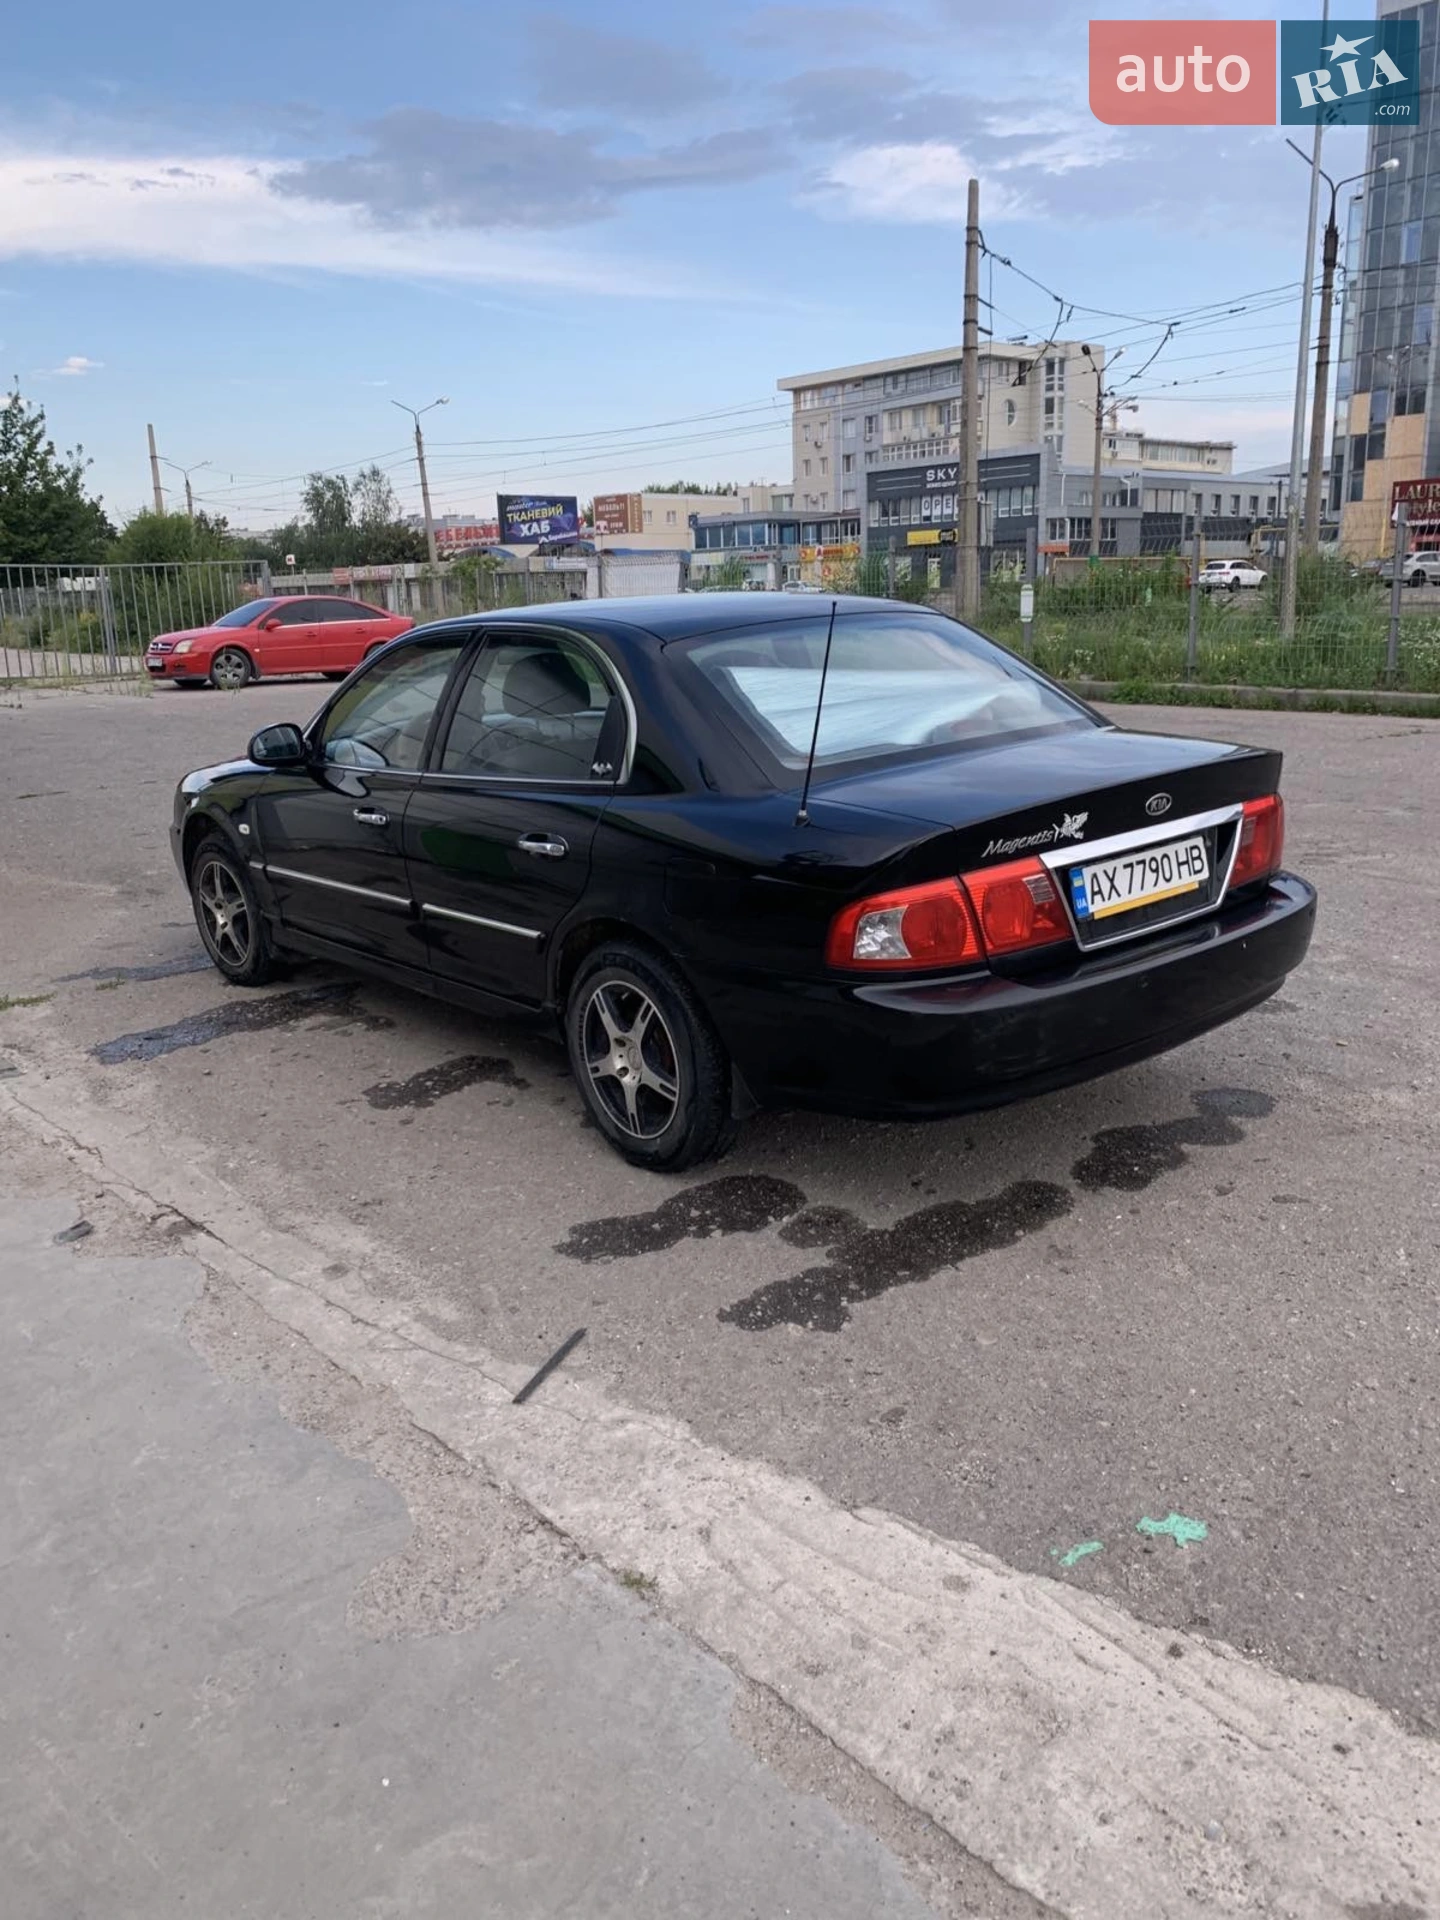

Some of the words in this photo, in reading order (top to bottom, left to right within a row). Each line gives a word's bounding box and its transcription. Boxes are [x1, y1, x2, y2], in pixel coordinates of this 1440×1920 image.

[926, 467, 958, 482] SKY
[506, 503, 564, 523] ТКАНЕВИЙ
[520, 520, 551, 538] ХАБ
[1149, 797, 1169, 813] KIA
[981, 829, 1054, 858] Magentis
[1089, 868, 1122, 906] AX
[1123, 856, 1174, 896] 7790
[1175, 845, 1205, 881] HB
[1076, 898, 1088, 910] UA
